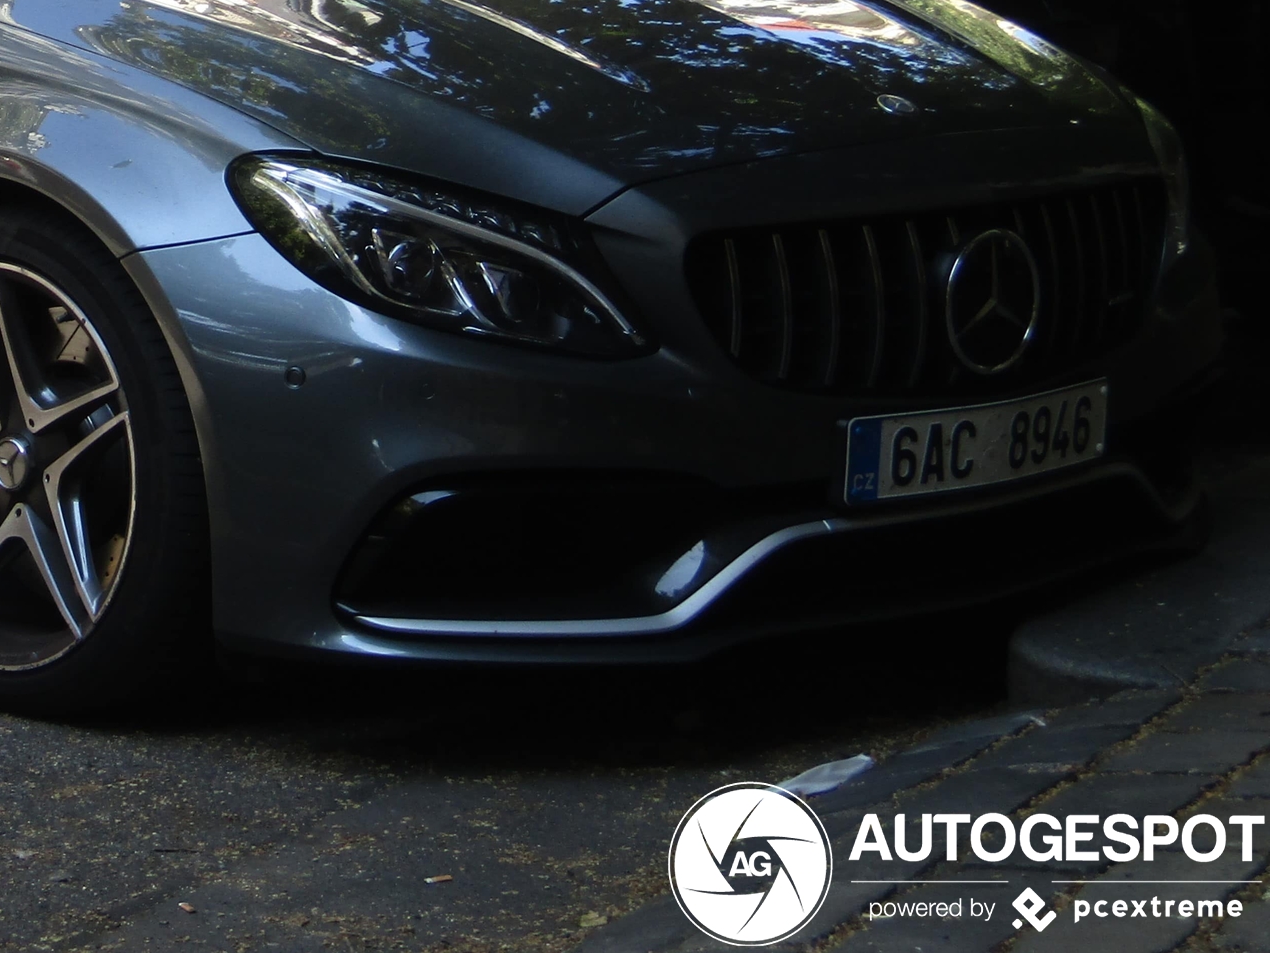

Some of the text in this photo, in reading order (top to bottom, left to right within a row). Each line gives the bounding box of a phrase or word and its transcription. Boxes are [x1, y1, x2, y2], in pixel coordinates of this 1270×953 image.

[891, 395, 1092, 487] 6AC 8946
[853, 471, 875, 491] CZ
